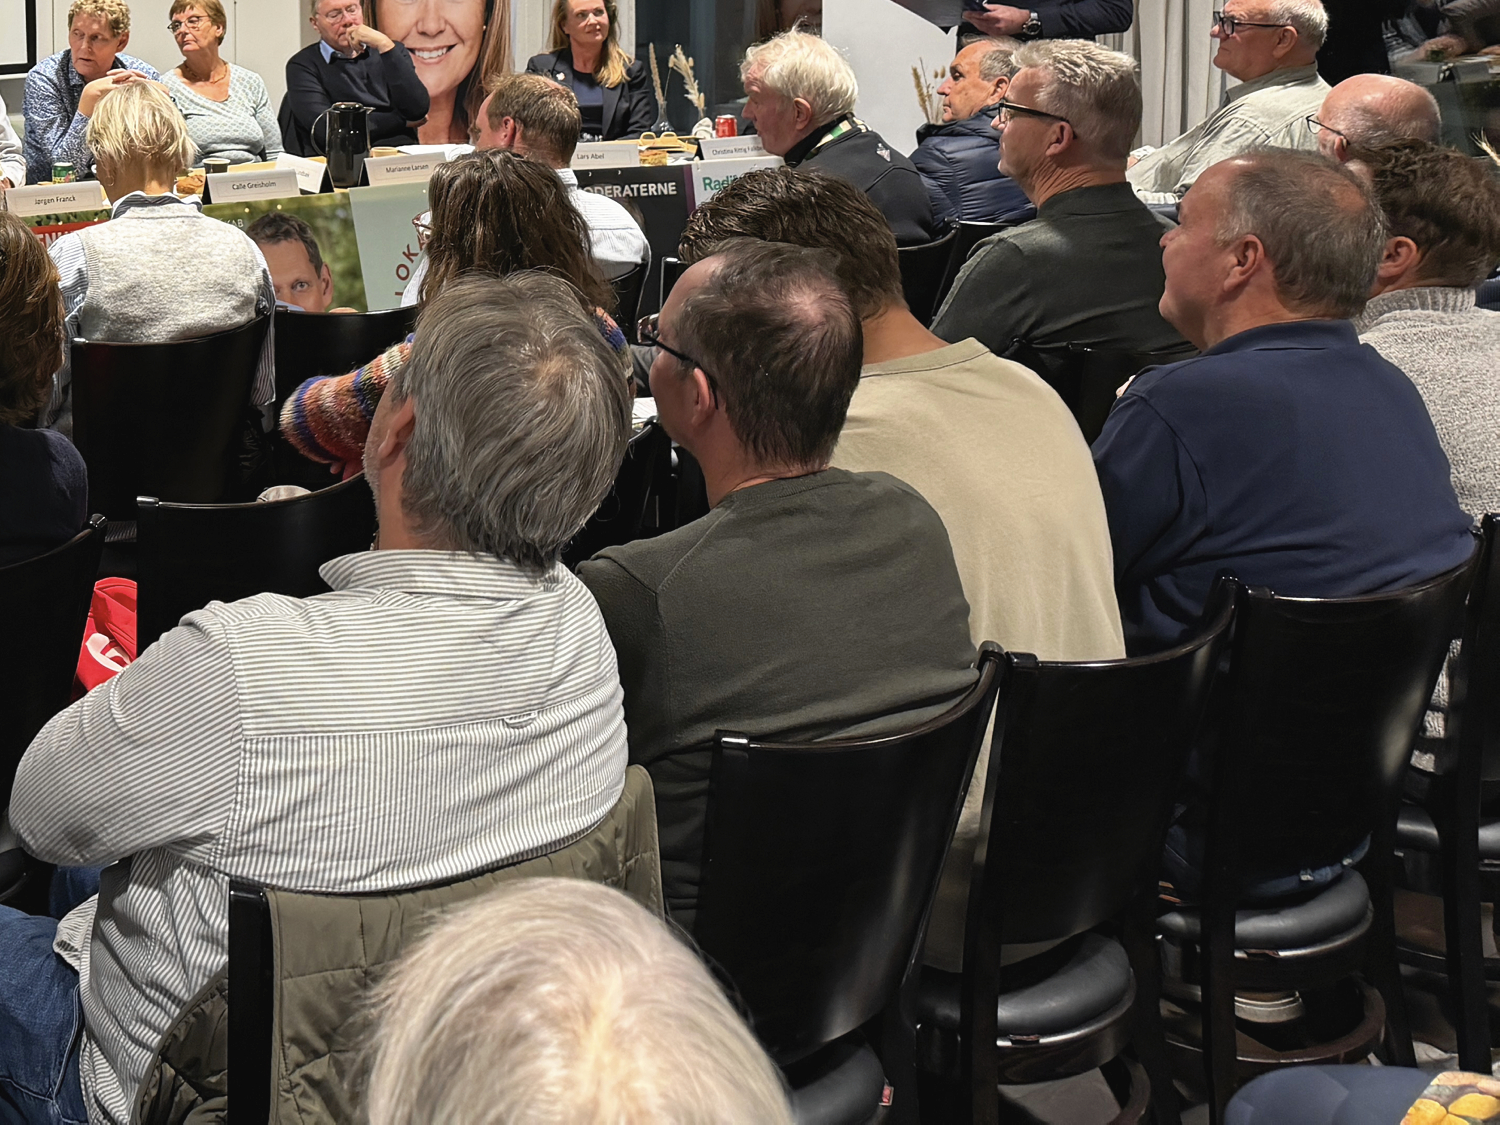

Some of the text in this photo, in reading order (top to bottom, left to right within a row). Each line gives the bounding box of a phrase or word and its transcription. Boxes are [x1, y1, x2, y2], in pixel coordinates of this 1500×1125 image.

[590, 152, 605, 160] Abel
[385, 163, 430, 174] Marianne Larsen
[232, 181, 277, 191] Calle Greisholm
[583, 182, 678, 199] DERATERNE
[34, 195, 76, 206] Jørgen Franck
